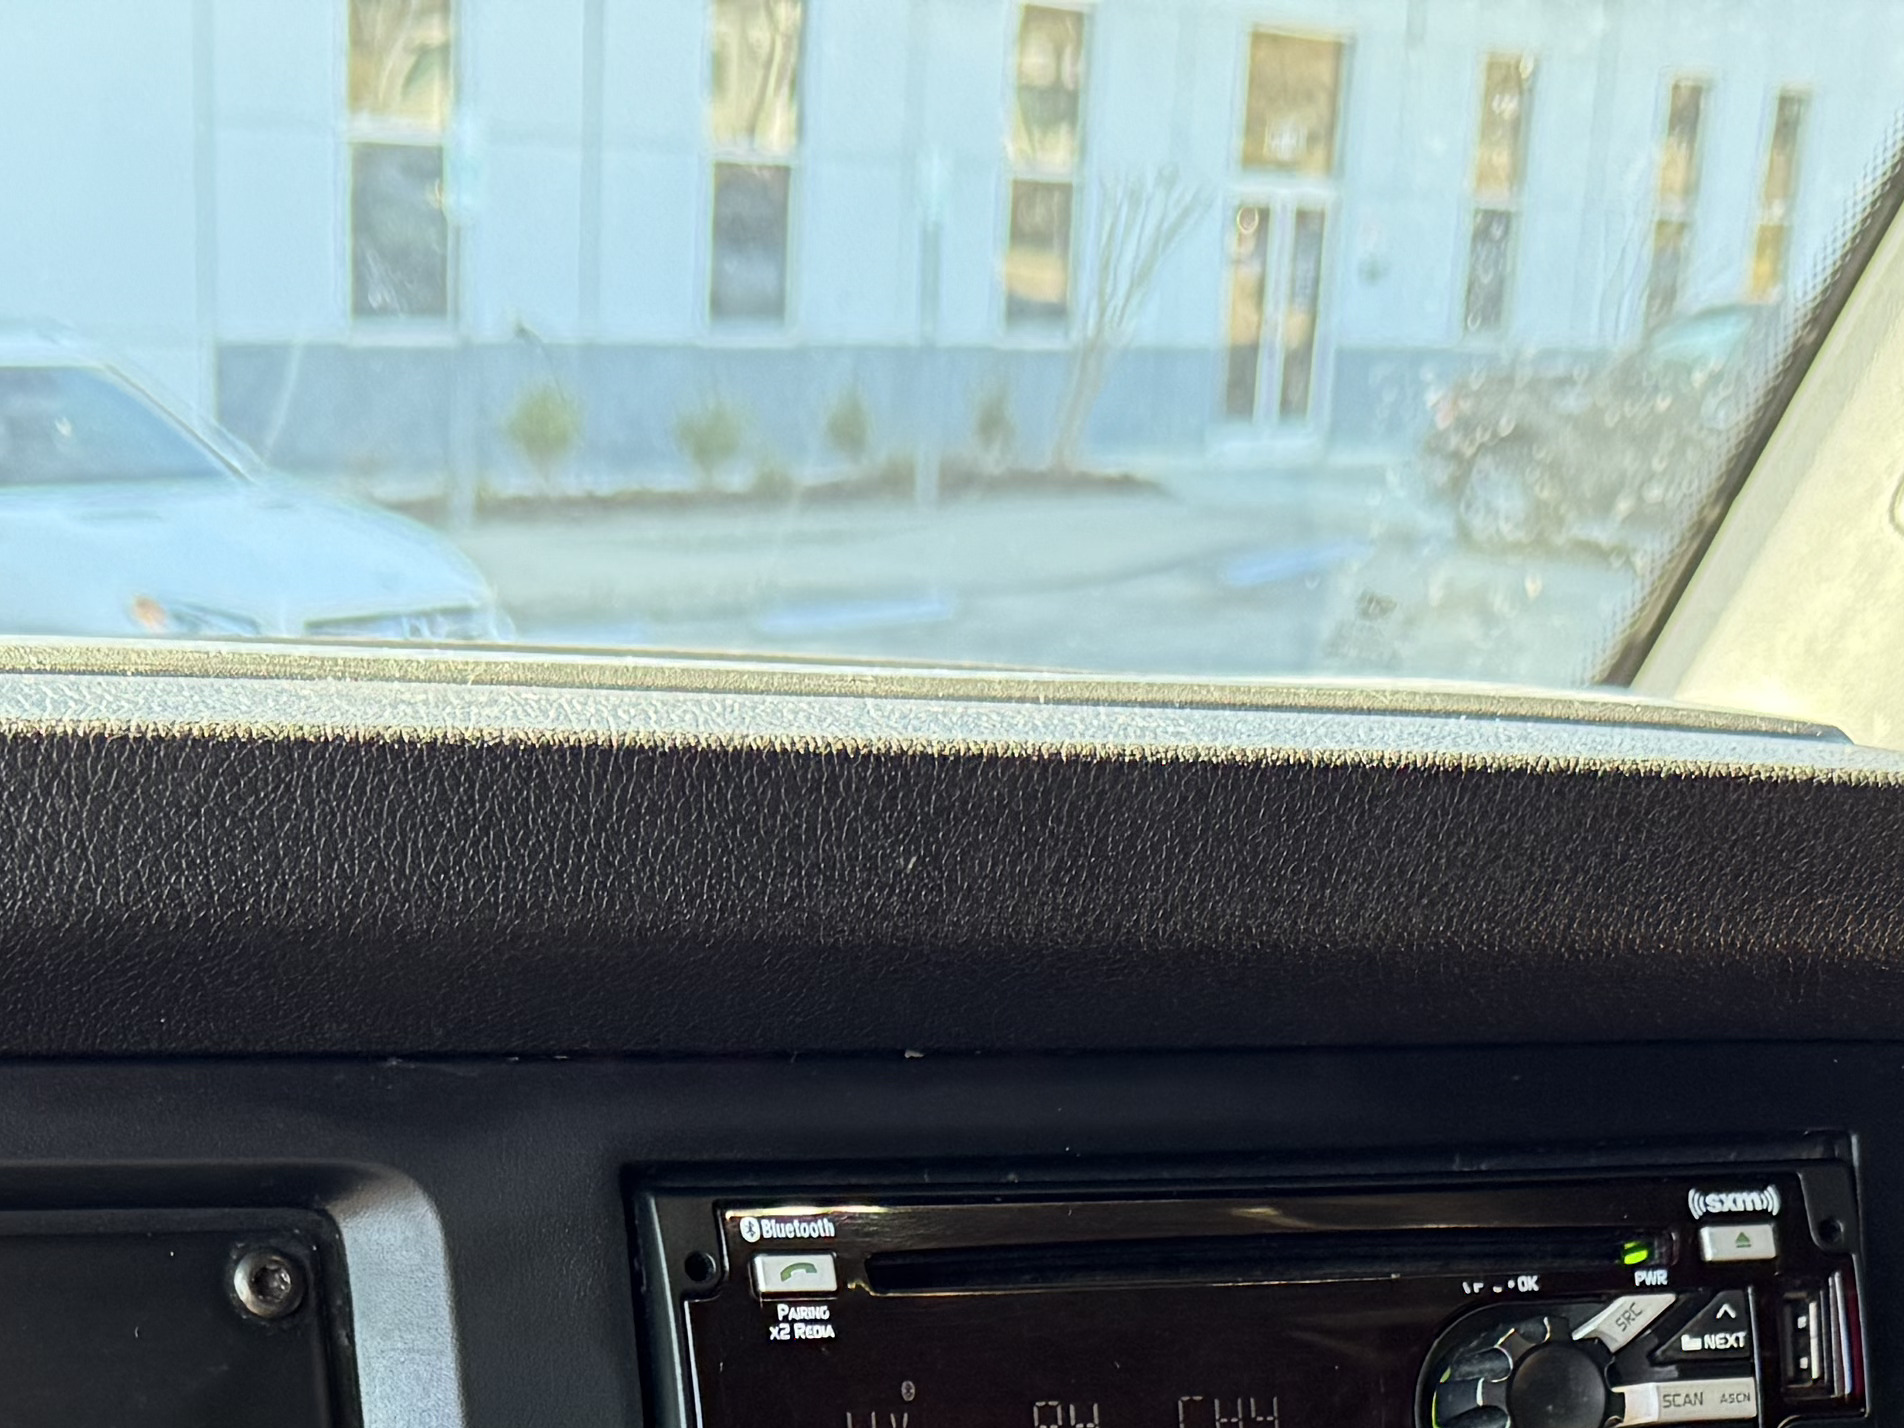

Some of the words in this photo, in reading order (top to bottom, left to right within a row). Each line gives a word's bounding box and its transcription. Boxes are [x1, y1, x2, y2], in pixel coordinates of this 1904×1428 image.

[760, 1218, 836, 1239] Bluetooth
[1635, 1269, 1668, 1287] PWR
[1615, 1301, 1644, 1332] SRC
[1703, 1332, 1747, 1350] NEXT
[1662, 1391, 1704, 1409] SCAN
